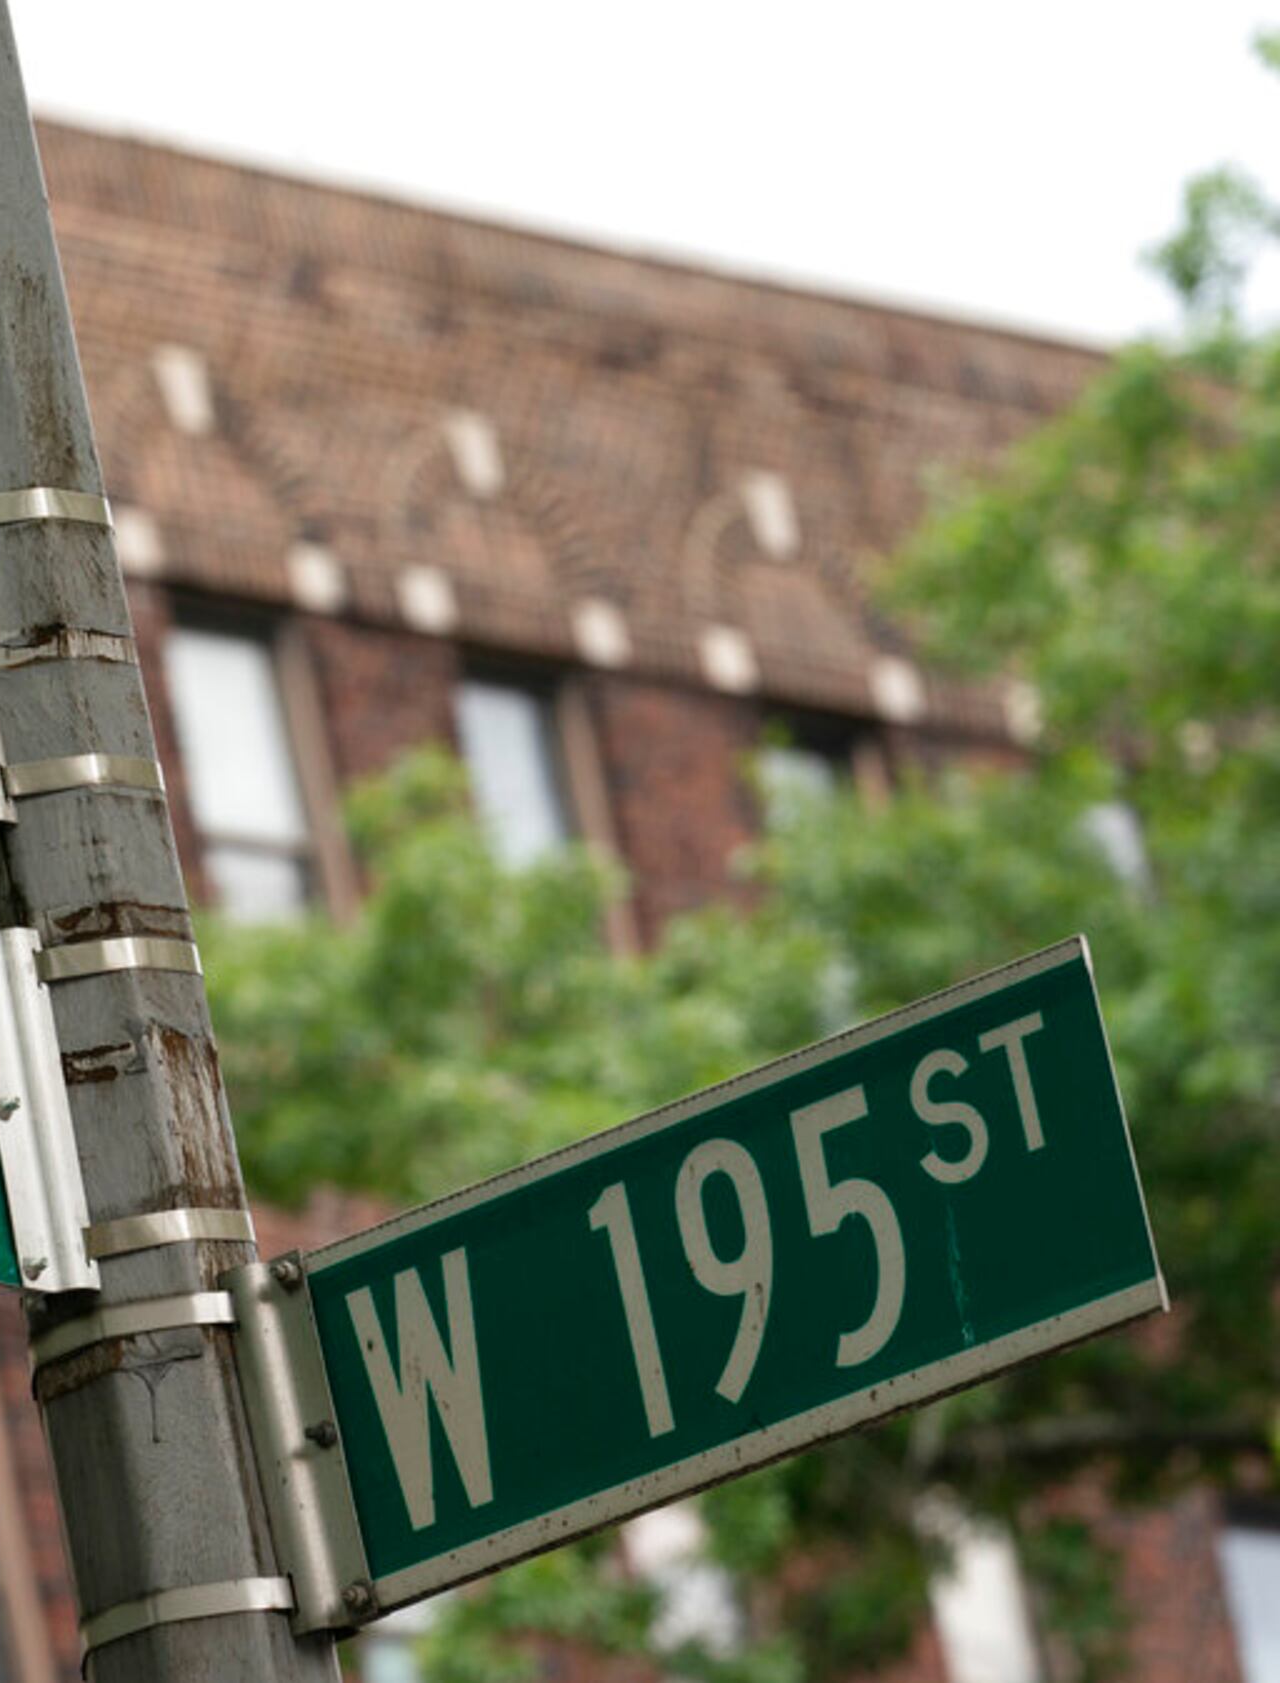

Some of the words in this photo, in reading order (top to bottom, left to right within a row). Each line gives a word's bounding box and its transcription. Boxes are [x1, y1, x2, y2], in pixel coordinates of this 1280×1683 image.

[345, 1246, 494, 1531] W
[587, 1085, 907, 1439] 195
[909, 1011, 1045, 1184] ST
